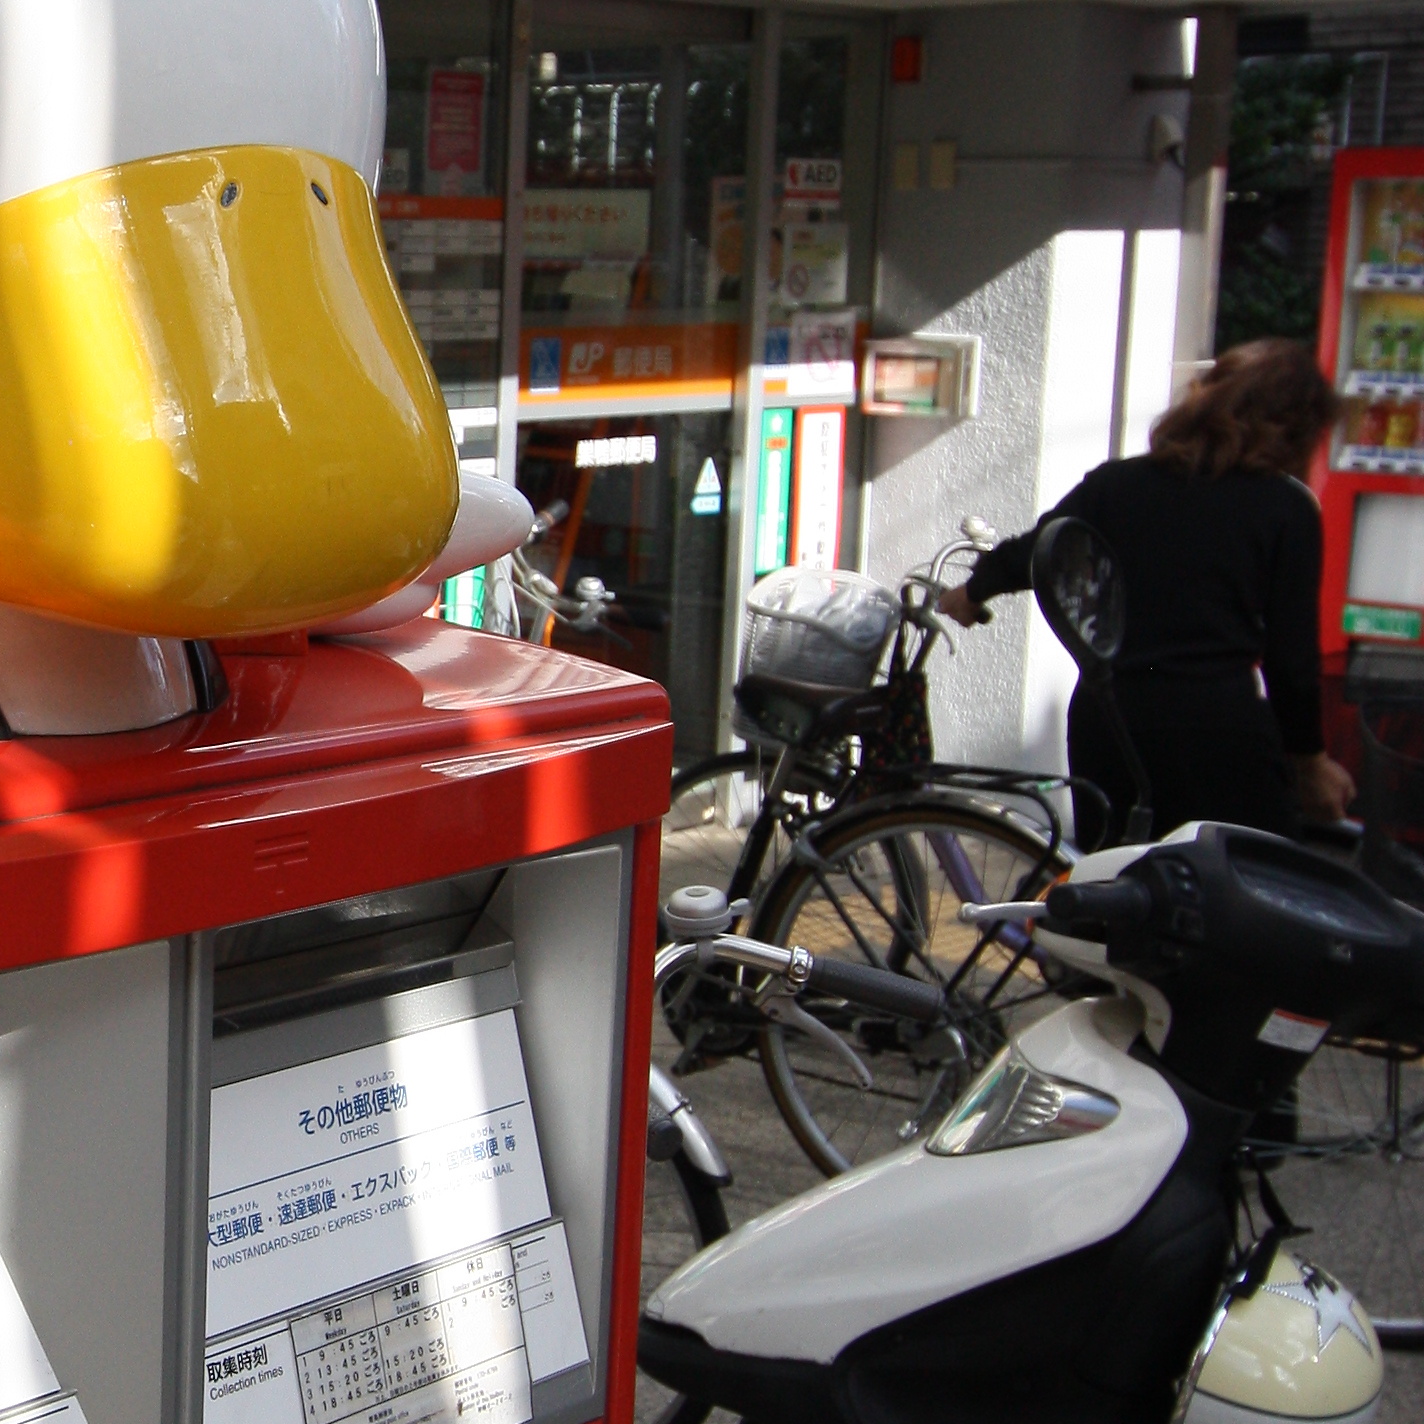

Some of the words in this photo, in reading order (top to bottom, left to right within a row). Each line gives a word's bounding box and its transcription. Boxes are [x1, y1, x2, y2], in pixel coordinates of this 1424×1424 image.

[298, 1082, 409, 1136] その他郵便物
[339, 1122, 381, 1145] OTHERS
[328, 1208, 374, 1234] EXPRESS
[379, 1194, 417, 1218] EXPACK
[493, 1162, 515, 1179] MAIL
[391, 1280, 420, 1302] 土曜日
[323, 1307, 344, 1327] 平日
[206, 1343, 269, 1384] 取集時刻
[209, 1374, 257, 1401] Collection
[258, 1366, 284, 1382] times
